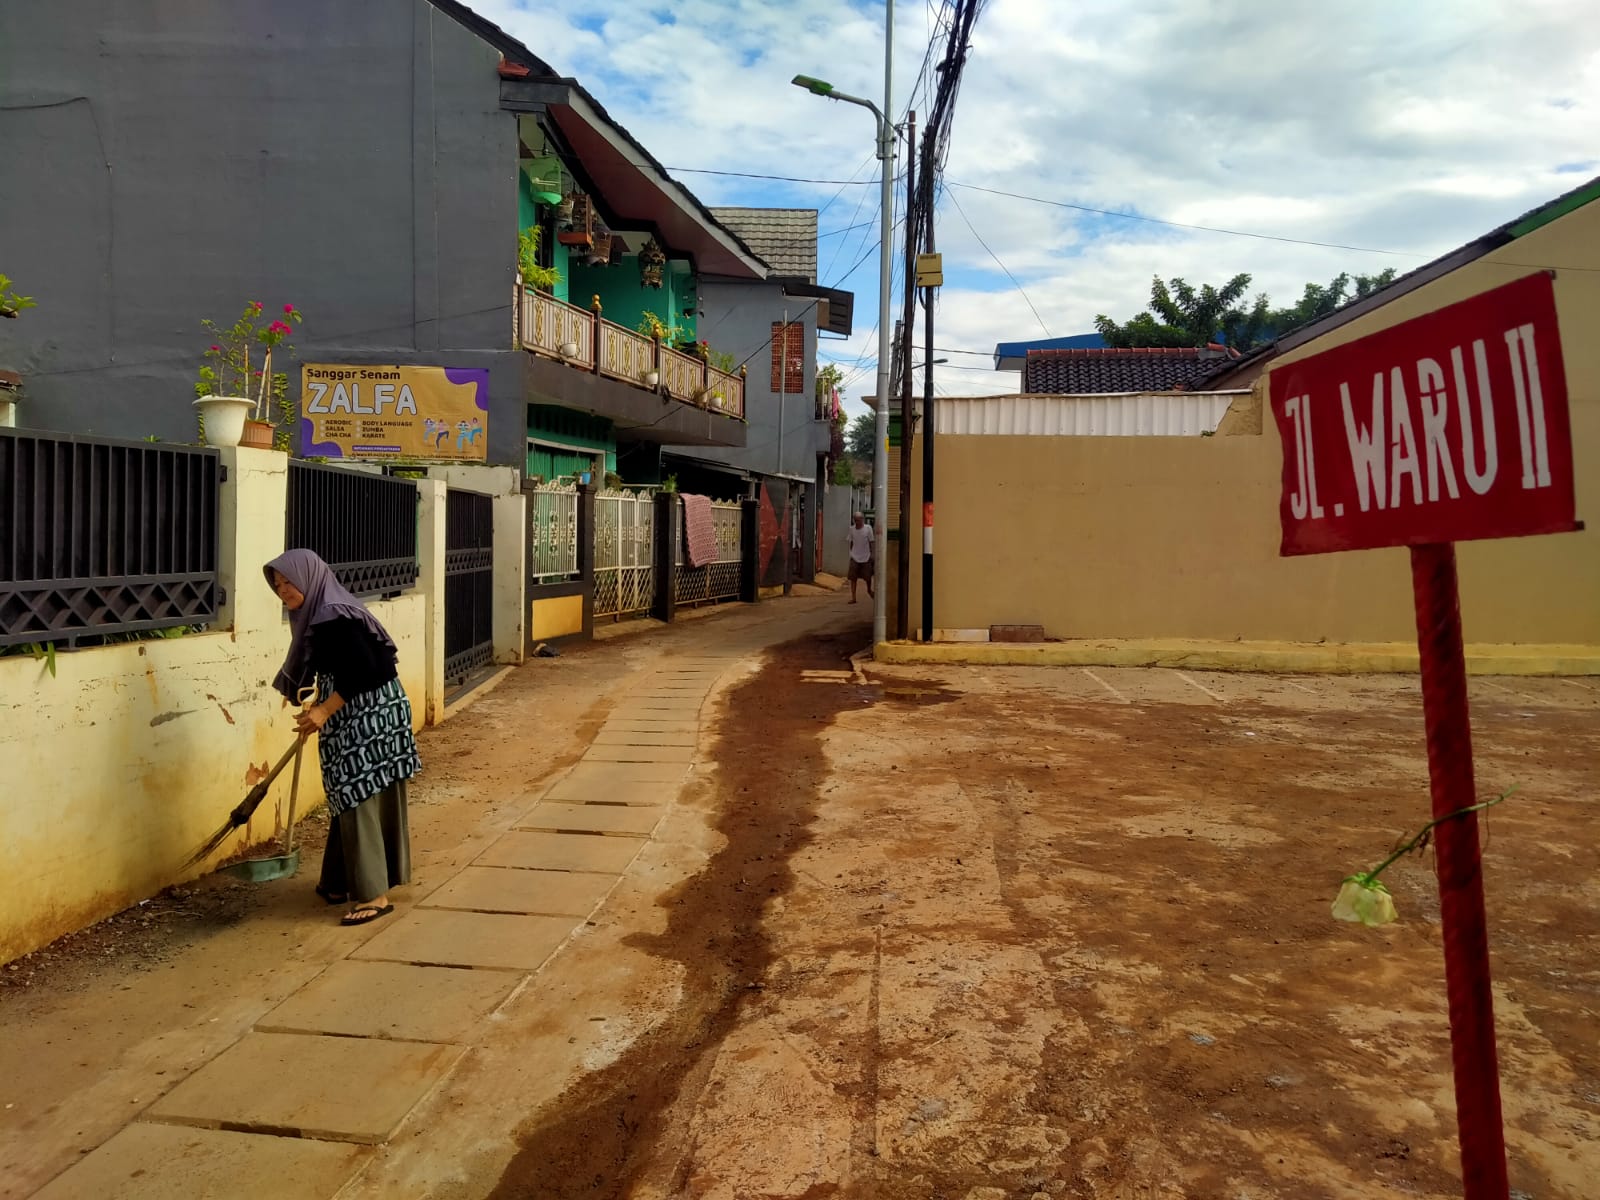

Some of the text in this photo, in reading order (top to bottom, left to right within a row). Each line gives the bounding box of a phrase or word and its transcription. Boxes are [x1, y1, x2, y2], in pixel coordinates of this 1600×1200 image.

[307, 368, 401, 381] Sanggar Senam
[307, 382, 418, 416] ZALFA
[1339, 338, 1499, 512] WARU
[1503, 322, 1552, 490] II
